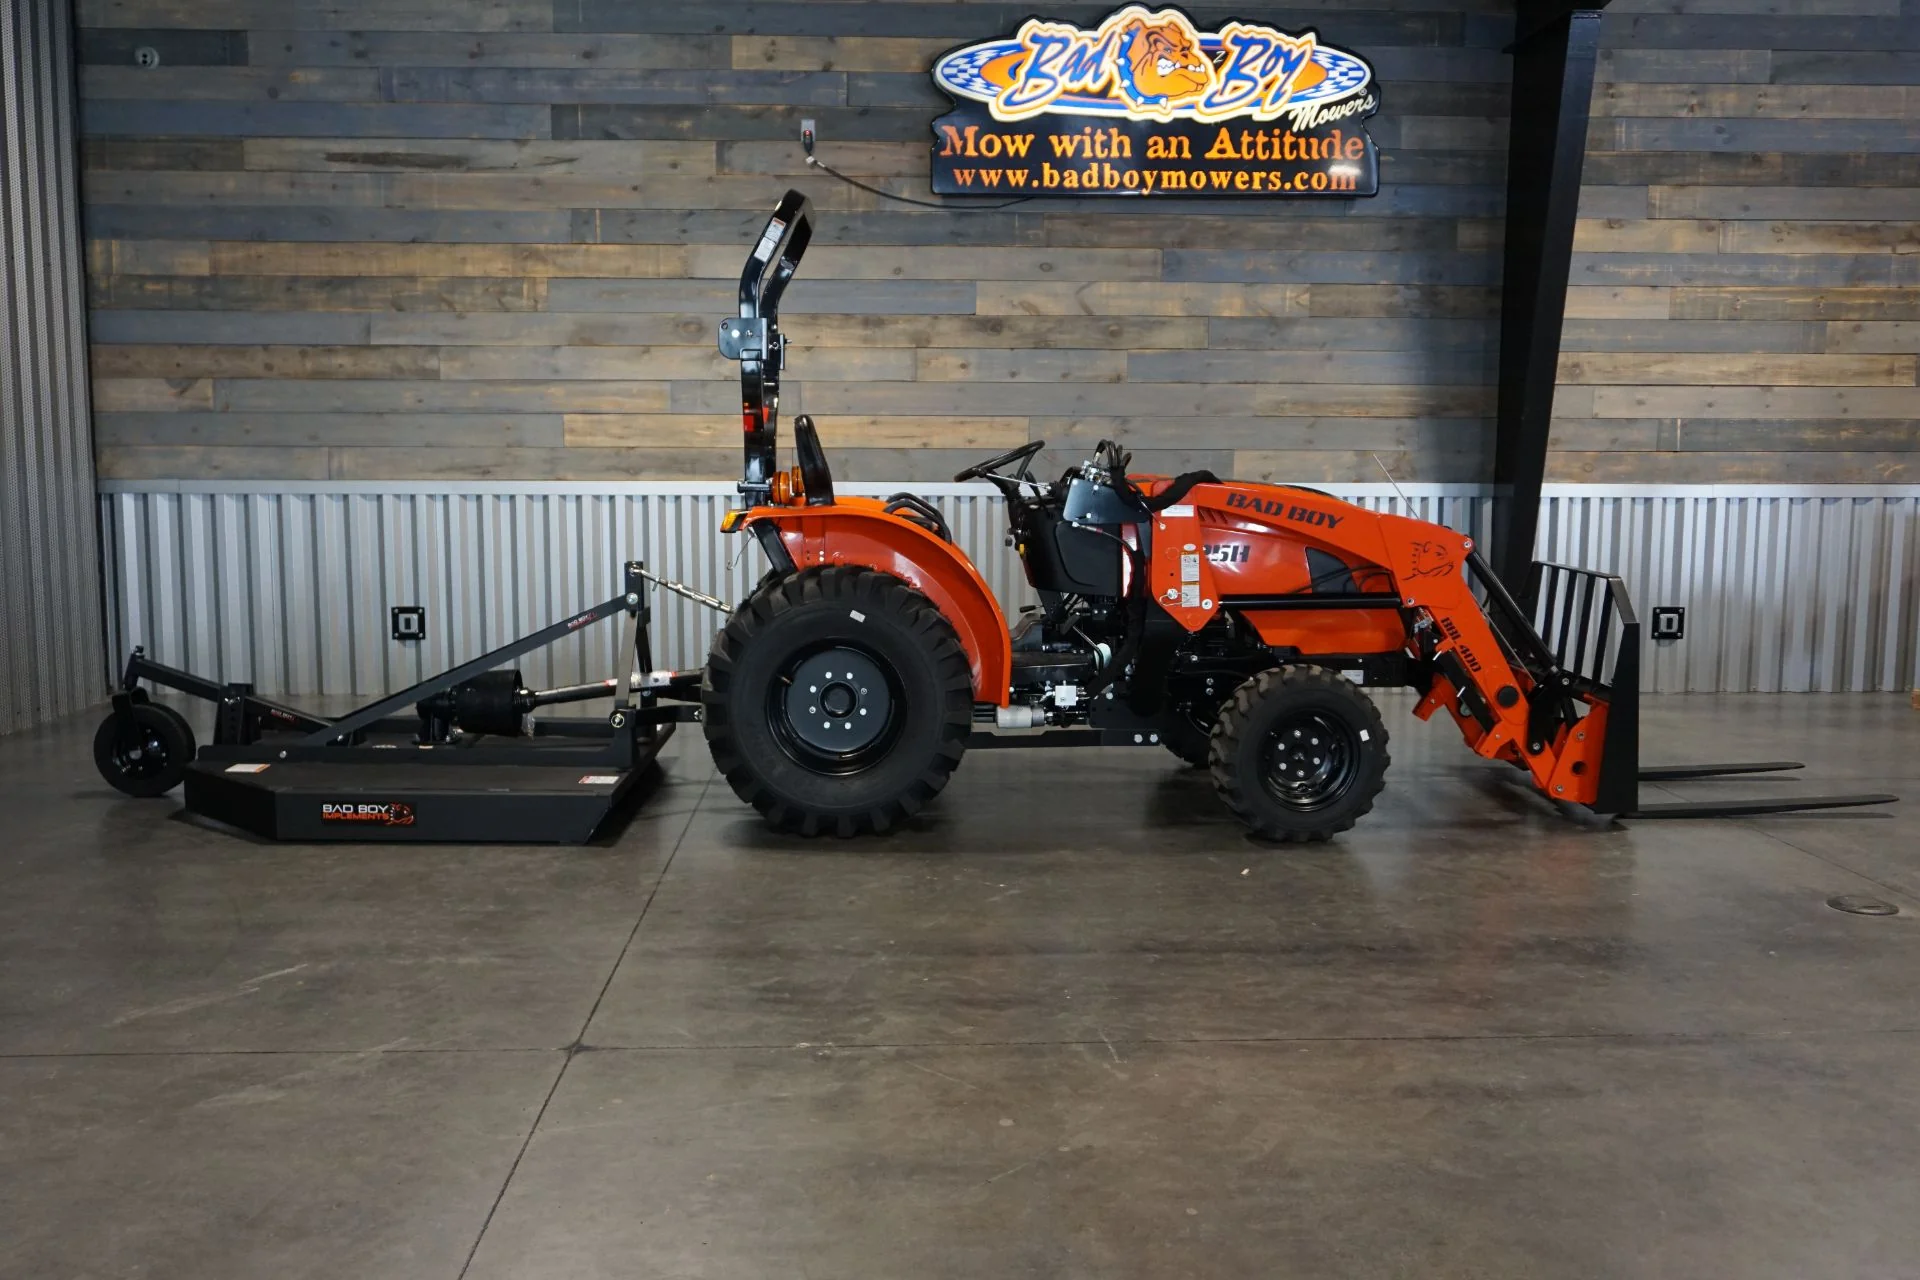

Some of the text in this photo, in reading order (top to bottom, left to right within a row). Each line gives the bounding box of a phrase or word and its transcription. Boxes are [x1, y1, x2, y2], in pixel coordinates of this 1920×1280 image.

[1003, 30, 1307, 109] Bad Boy
[1287, 93, 1377, 133] Mowers
[939, 125, 1365, 160] Mow with an Attitude
[952, 162, 1357, 195] www.badboymowers.com
[1226, 492, 1345, 529] BAD BOY
[1458, 644, 1482, 673] 400
[322, 804, 389, 814] BAD BOY
[322, 812, 390, 820] IMPLEMENTS
